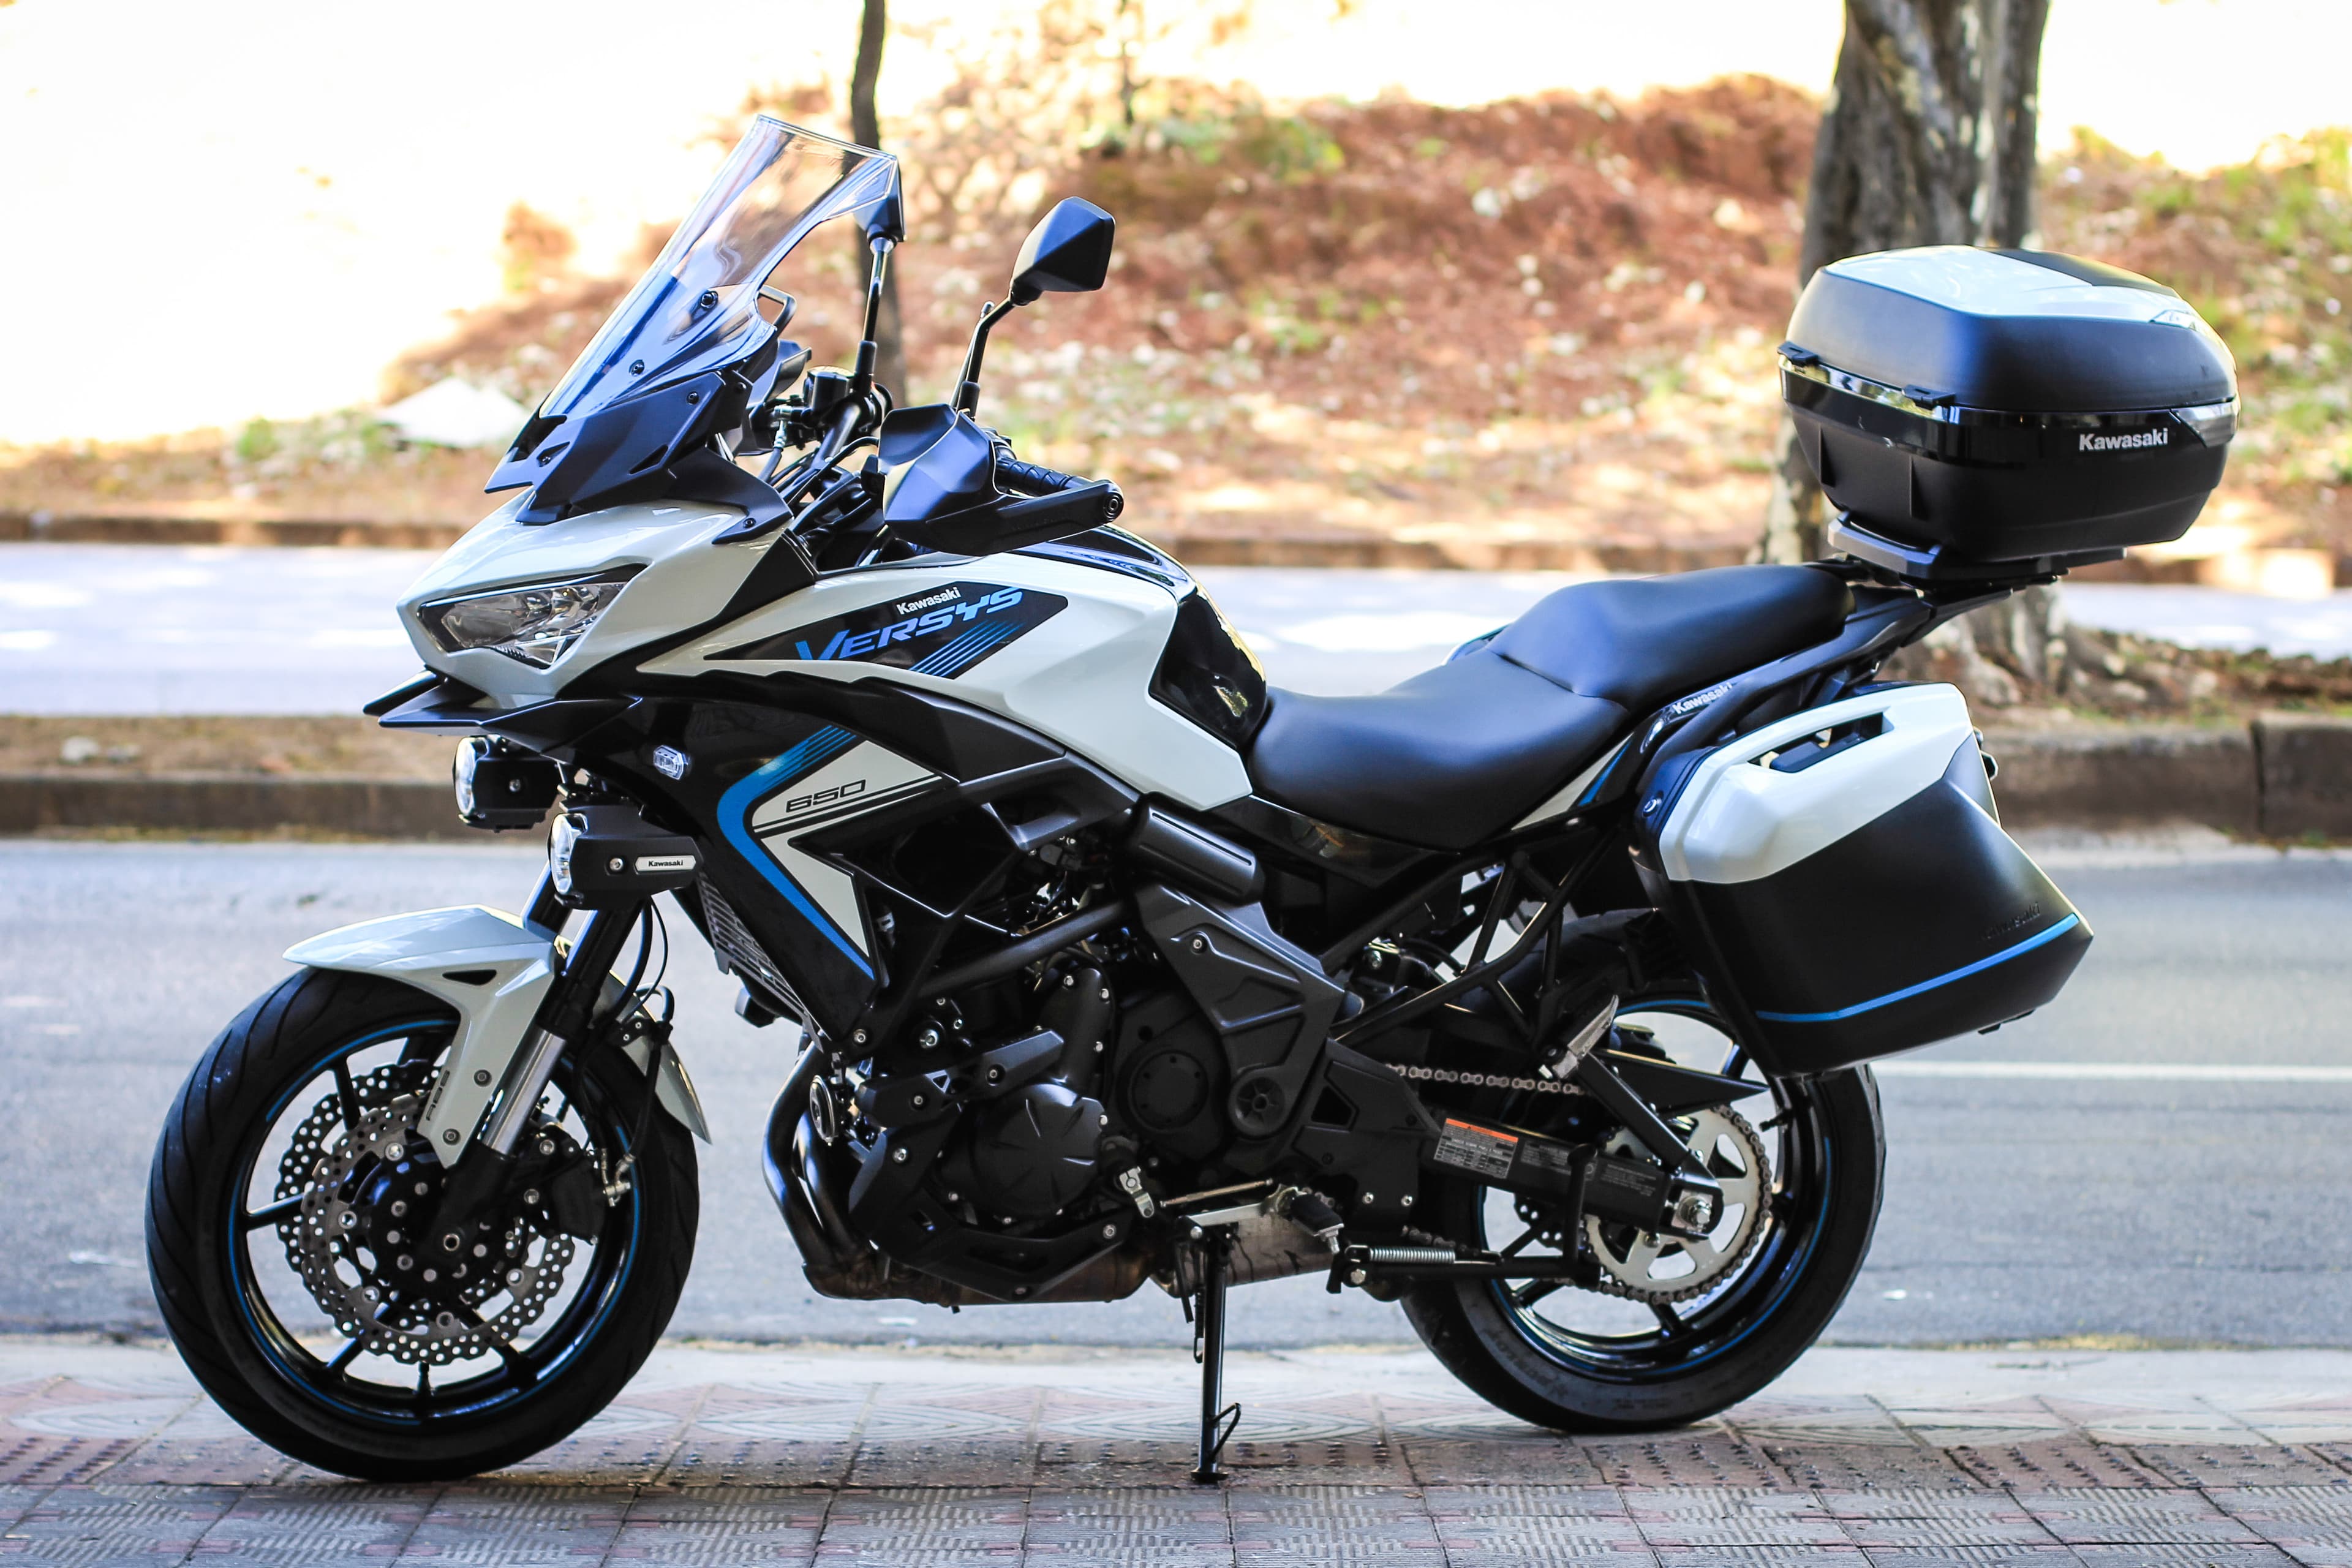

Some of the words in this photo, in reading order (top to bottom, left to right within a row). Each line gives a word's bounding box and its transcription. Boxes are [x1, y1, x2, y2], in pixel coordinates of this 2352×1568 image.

[2079, 428, 2169, 451] Kawasaki
[897, 586, 962, 615] Kawasaki
[794, 586, 1023, 661] VERSYS
[1672, 682, 1733, 715] Kawasaki
[786, 779, 866, 813] 650
